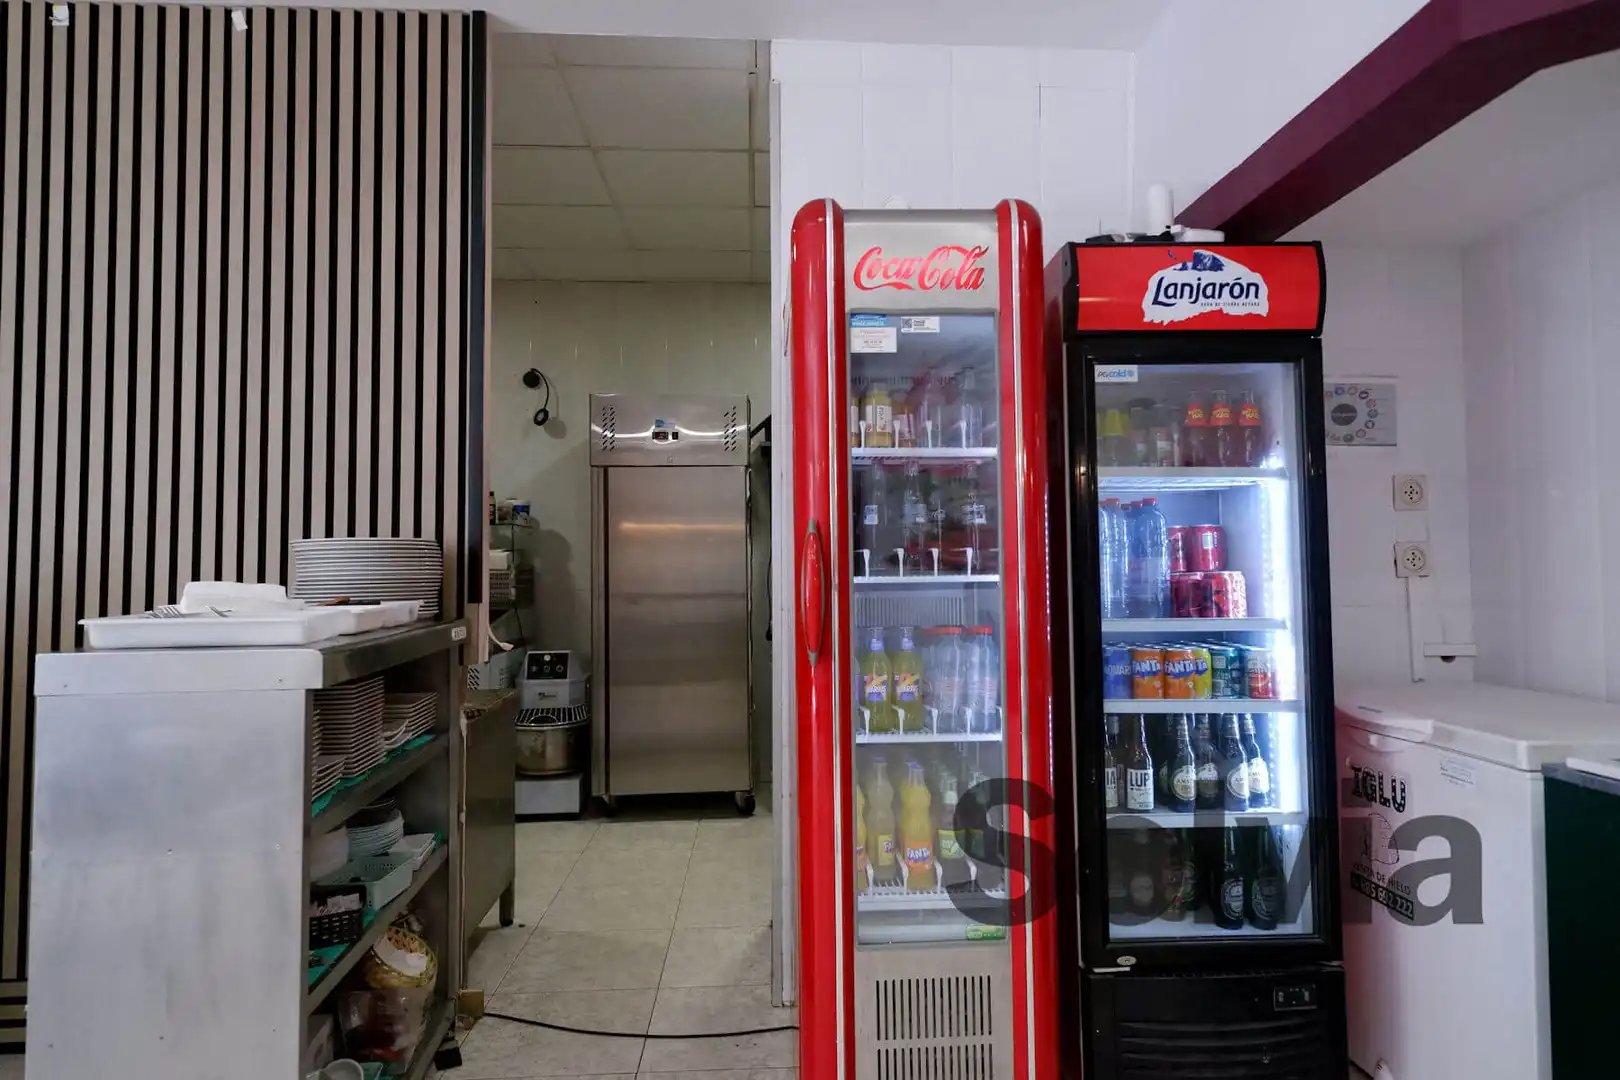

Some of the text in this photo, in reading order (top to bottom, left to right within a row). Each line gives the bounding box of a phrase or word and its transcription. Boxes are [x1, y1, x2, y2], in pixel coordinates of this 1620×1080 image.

[1151, 275, 1261, 308] Lanjarón
[1351, 766, 1406, 813] IGLU
[1376, 871, 1386, 884] DE
